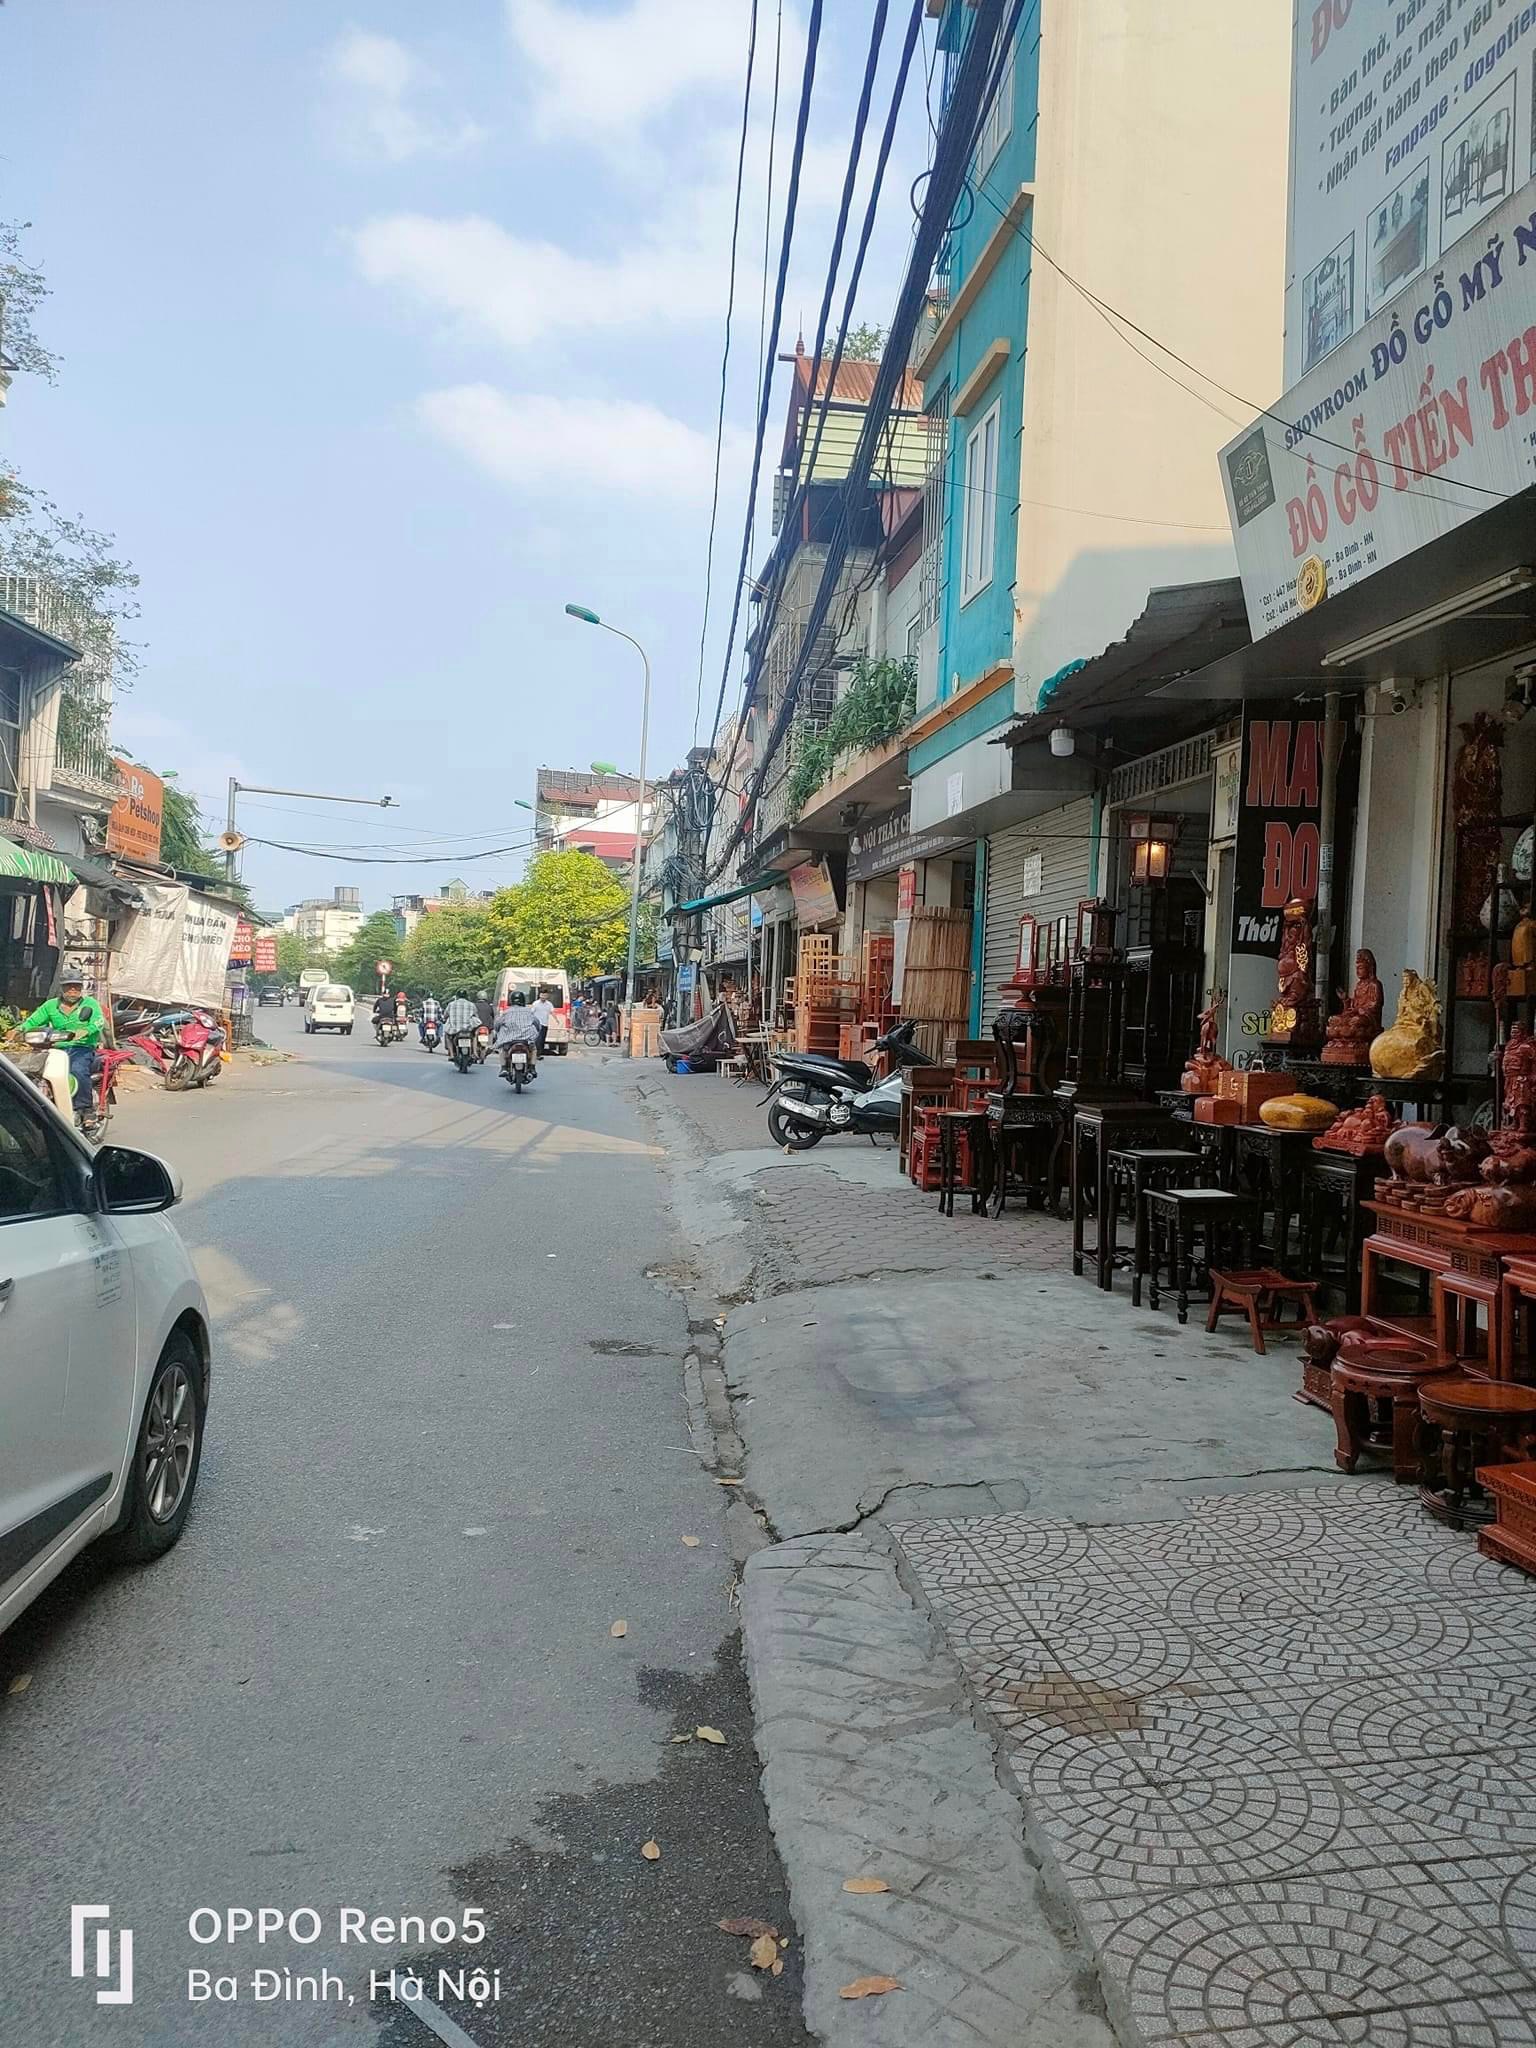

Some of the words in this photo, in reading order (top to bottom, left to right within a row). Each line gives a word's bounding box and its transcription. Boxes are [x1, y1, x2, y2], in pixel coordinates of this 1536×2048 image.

[1326, 145, 1358, 195] Nhận
[1425, 37, 1458, 88] theo
[1385, 94, 1448, 176] Fanpage
[1284, 368, 1368, 450] SHOWROOM
[1370, 311, 1407, 381] ĐỒ
[1414, 270, 1453, 345] GỖ
[1459, 233, 1504, 312] MỸ
[1285, 452, 1329, 559] ĐỒ
[1334, 413, 1379, 526] GỖ
[1384, 364, 1474, 491] TIẾN
[129, 798, 160, 828] Petshop
[1237, 915, 1279, 942] Thời
